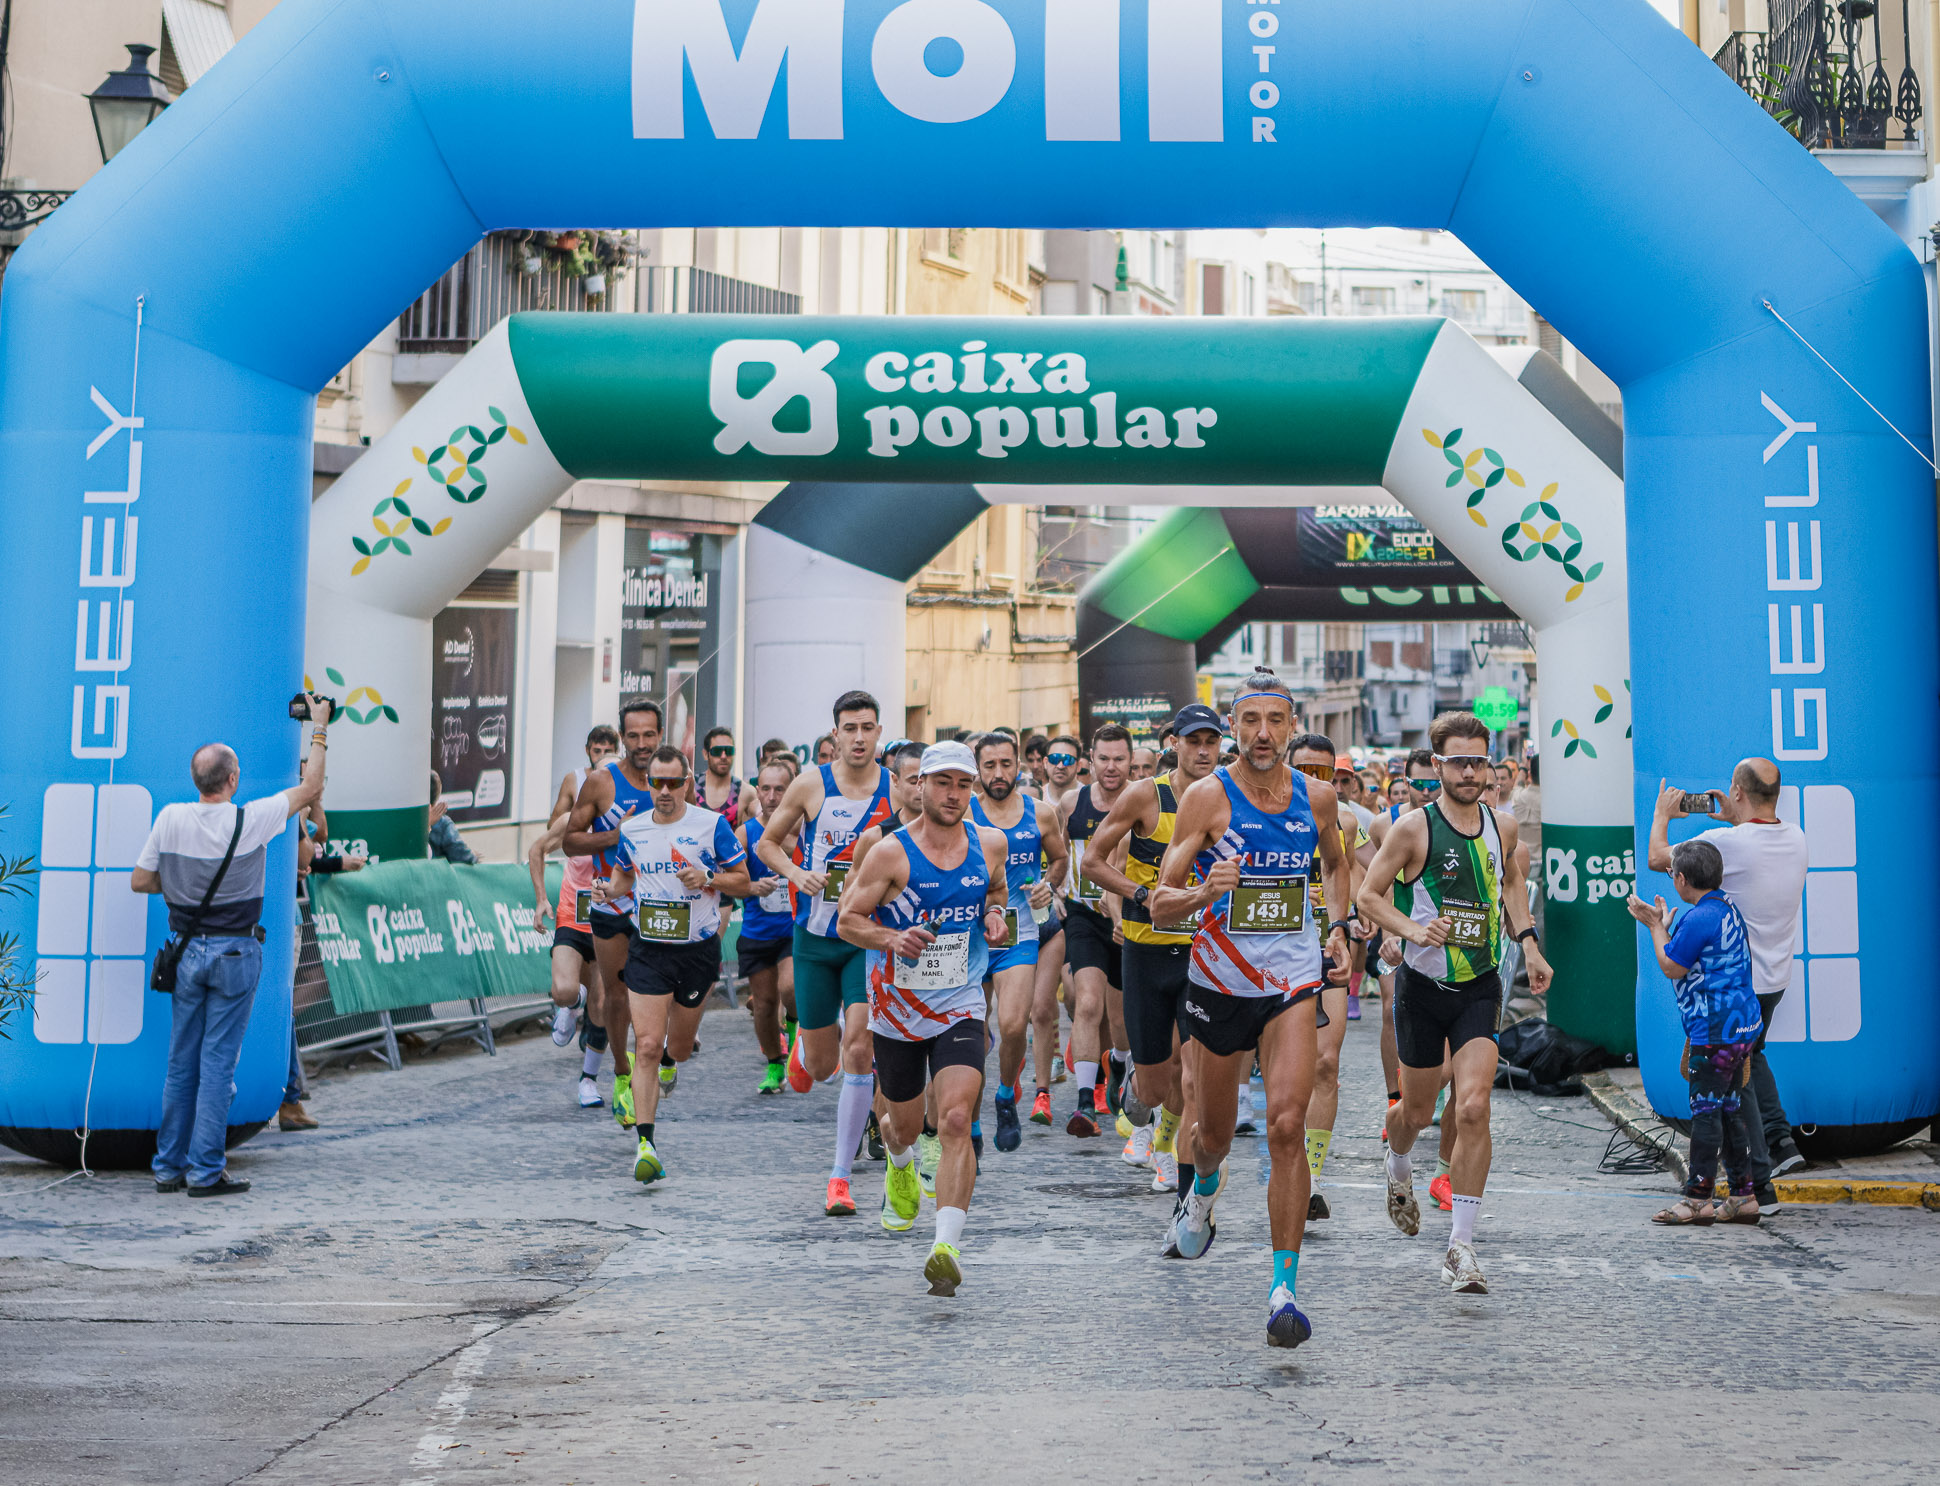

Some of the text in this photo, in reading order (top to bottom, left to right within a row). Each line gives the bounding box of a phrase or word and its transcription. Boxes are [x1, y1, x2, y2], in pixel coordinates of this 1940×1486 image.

[632, 0, 1224, 142] Moll
[1247, 0, 1280, 143] OTOR
[864, 340, 1090, 394] caixa
[864, 391, 1217, 458] popular
[1314, 504, 1413, 518] SAFOR-VALL
[1346, 528, 1435, 561] IX EDICIÓ
[71, 385, 144, 759] GEELY
[1761, 390, 1828, 761] GEELY
[664, 572, 709, 608] Dental
[641, 675, 652, 692] en
[1106, 698, 1153, 706] CIRCUIT
[1476, 702, 1517, 718] 08:59
[821, 830, 863, 846] ALP
[640, 861, 688, 875] ALPESA
[1005, 852, 1034, 866] ESA
[1239, 851, 1311, 869] ALPESA
[1586, 849, 1636, 875] cai
[390, 902, 425, 931] caixa
[916, 903, 980, 925] ALPESA
[1247, 902, 1288, 921] 1431
[1443, 908, 1458, 917] LUIS
[1458, 911, 1486, 920] HURTADO
[647, 917, 678, 931] 1457
[1448, 921, 1481, 937] 134
[395, 925, 444, 962] popular
[926, 944, 943, 952] GRAN
[926, 959, 940, 968] 83
